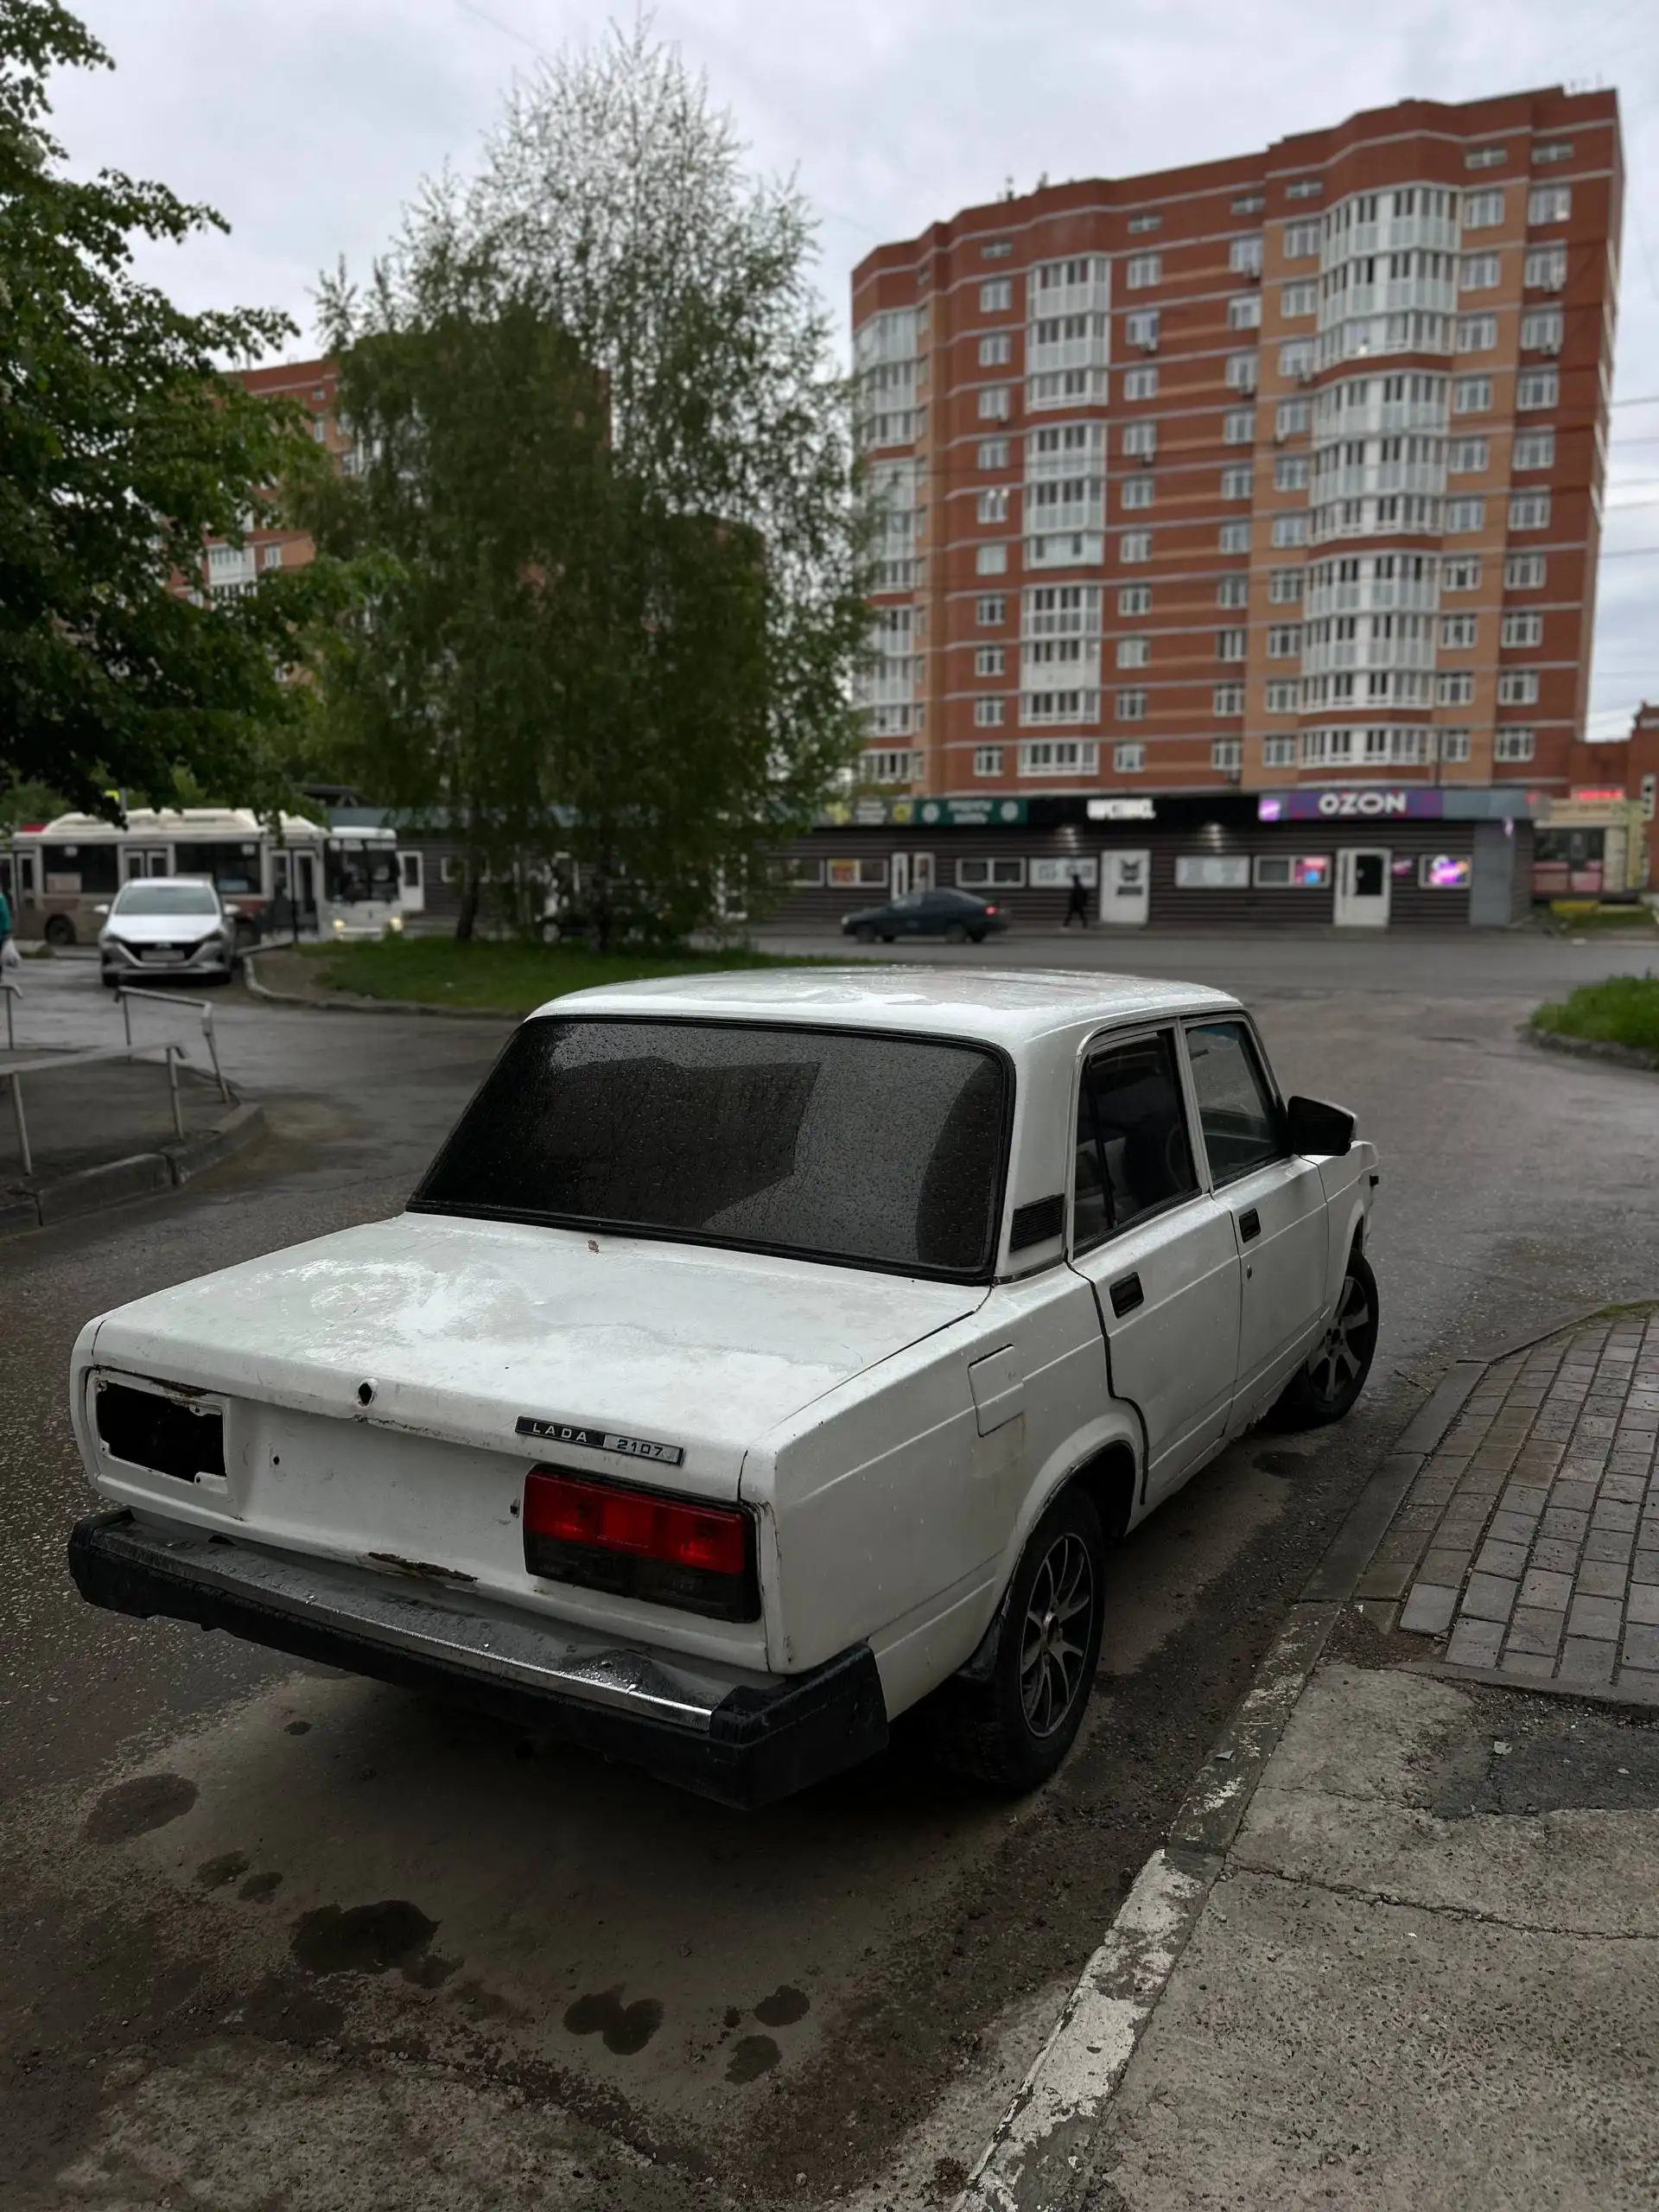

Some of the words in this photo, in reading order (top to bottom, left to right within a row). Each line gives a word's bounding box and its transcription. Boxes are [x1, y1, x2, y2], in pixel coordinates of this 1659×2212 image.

[1319, 791, 1407, 815] OZON
[532, 1422, 588, 1442] LADA
[617, 1439, 664, 1457] 2107
